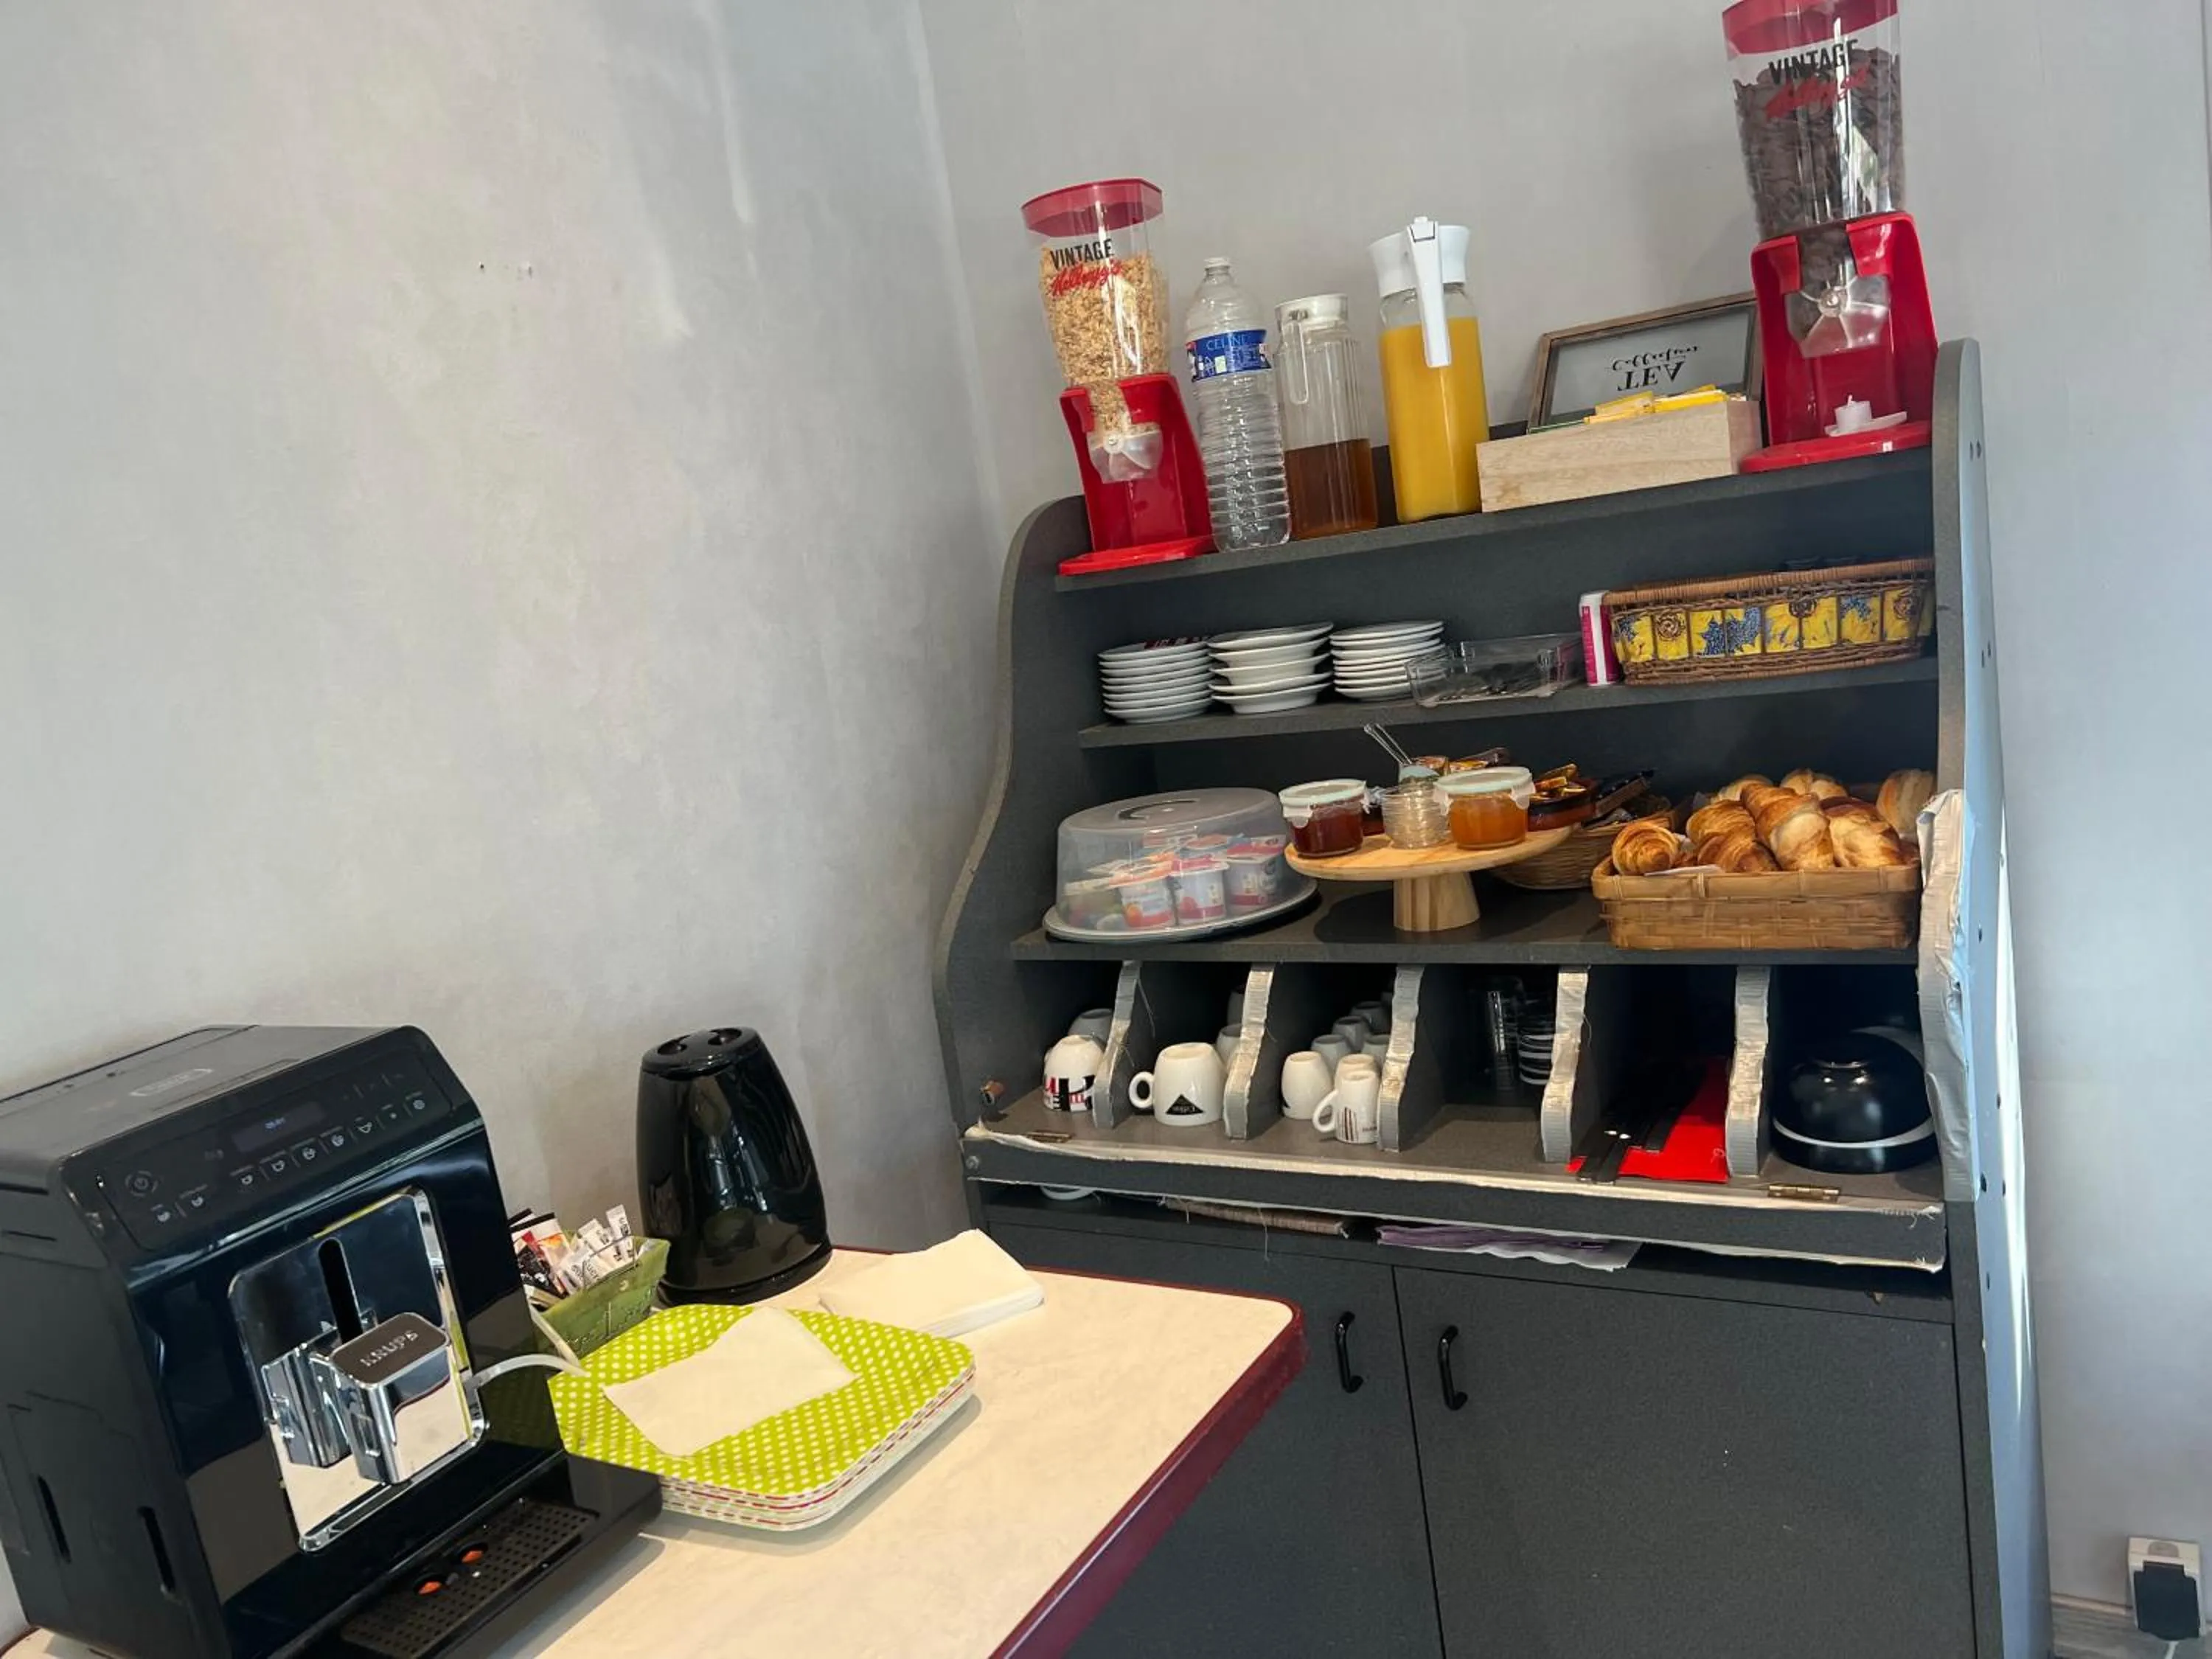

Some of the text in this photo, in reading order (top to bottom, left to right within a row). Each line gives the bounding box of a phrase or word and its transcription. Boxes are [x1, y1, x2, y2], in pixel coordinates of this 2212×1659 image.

[1768, 40, 1859, 85] VINTAGE
[1050, 239, 1114, 271] VINTAGE
[360, 1330, 419, 1366] KRUPS
